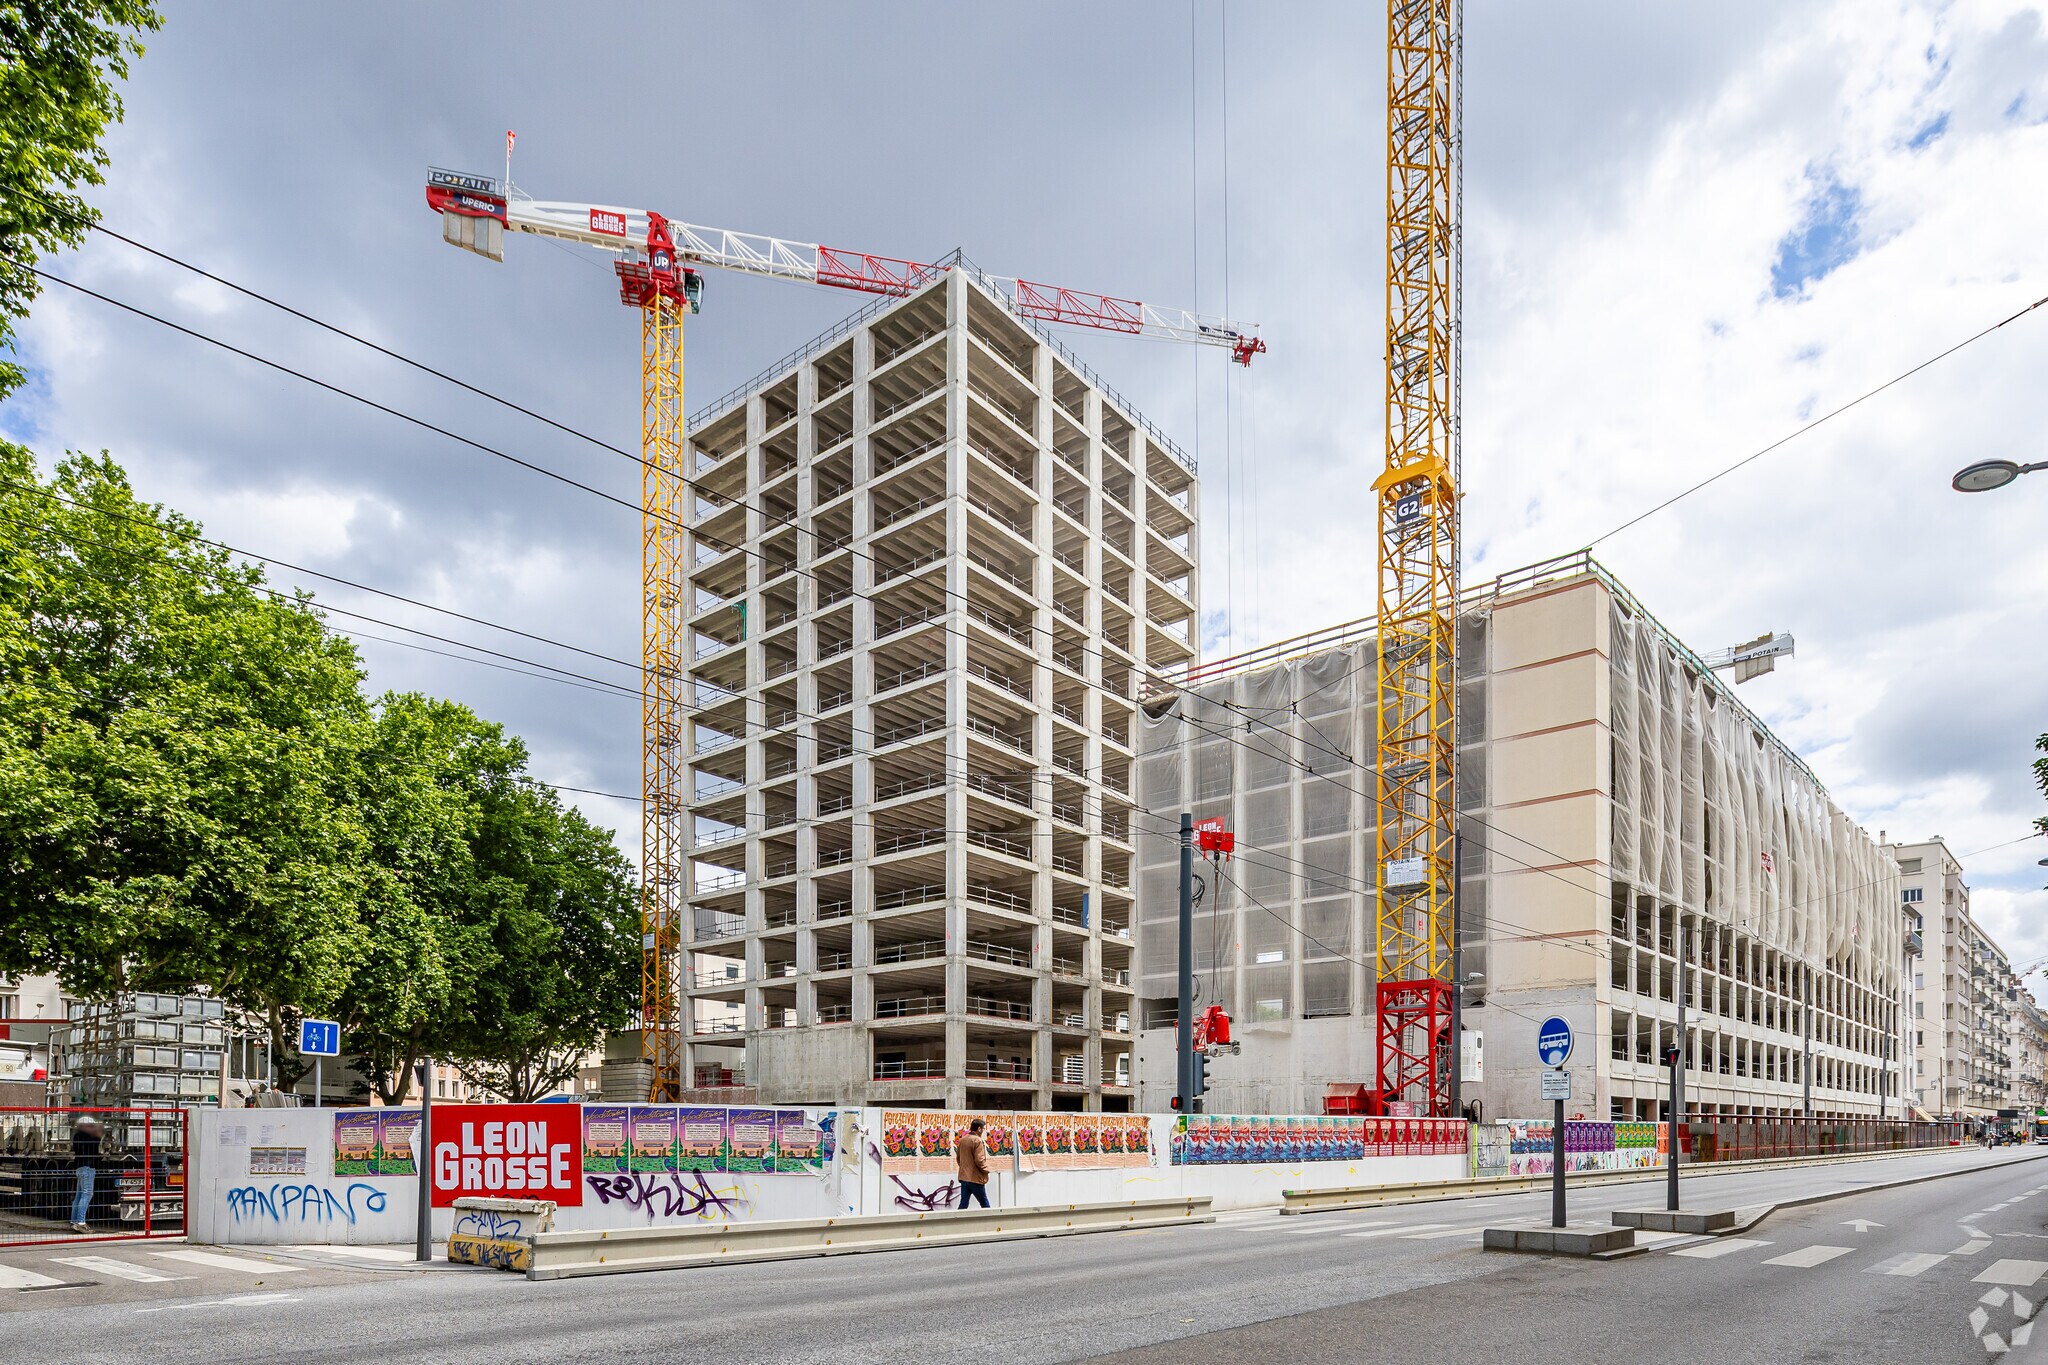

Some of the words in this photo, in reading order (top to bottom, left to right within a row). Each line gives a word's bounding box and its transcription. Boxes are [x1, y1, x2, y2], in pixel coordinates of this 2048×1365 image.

[432, 171, 491, 191] POTAIN
[462, 196, 495, 212] UPERIO
[592, 216, 624, 233] GROSSE
[598, 213, 619, 224] LEON
[1398, 500, 1418, 517] G2
[1752, 647, 1779, 657] POTAIN
[1199, 821, 1217, 832] LEON
[462, 1121, 547, 1154] LEON
[435, 1141, 571, 1190] GROSSE
